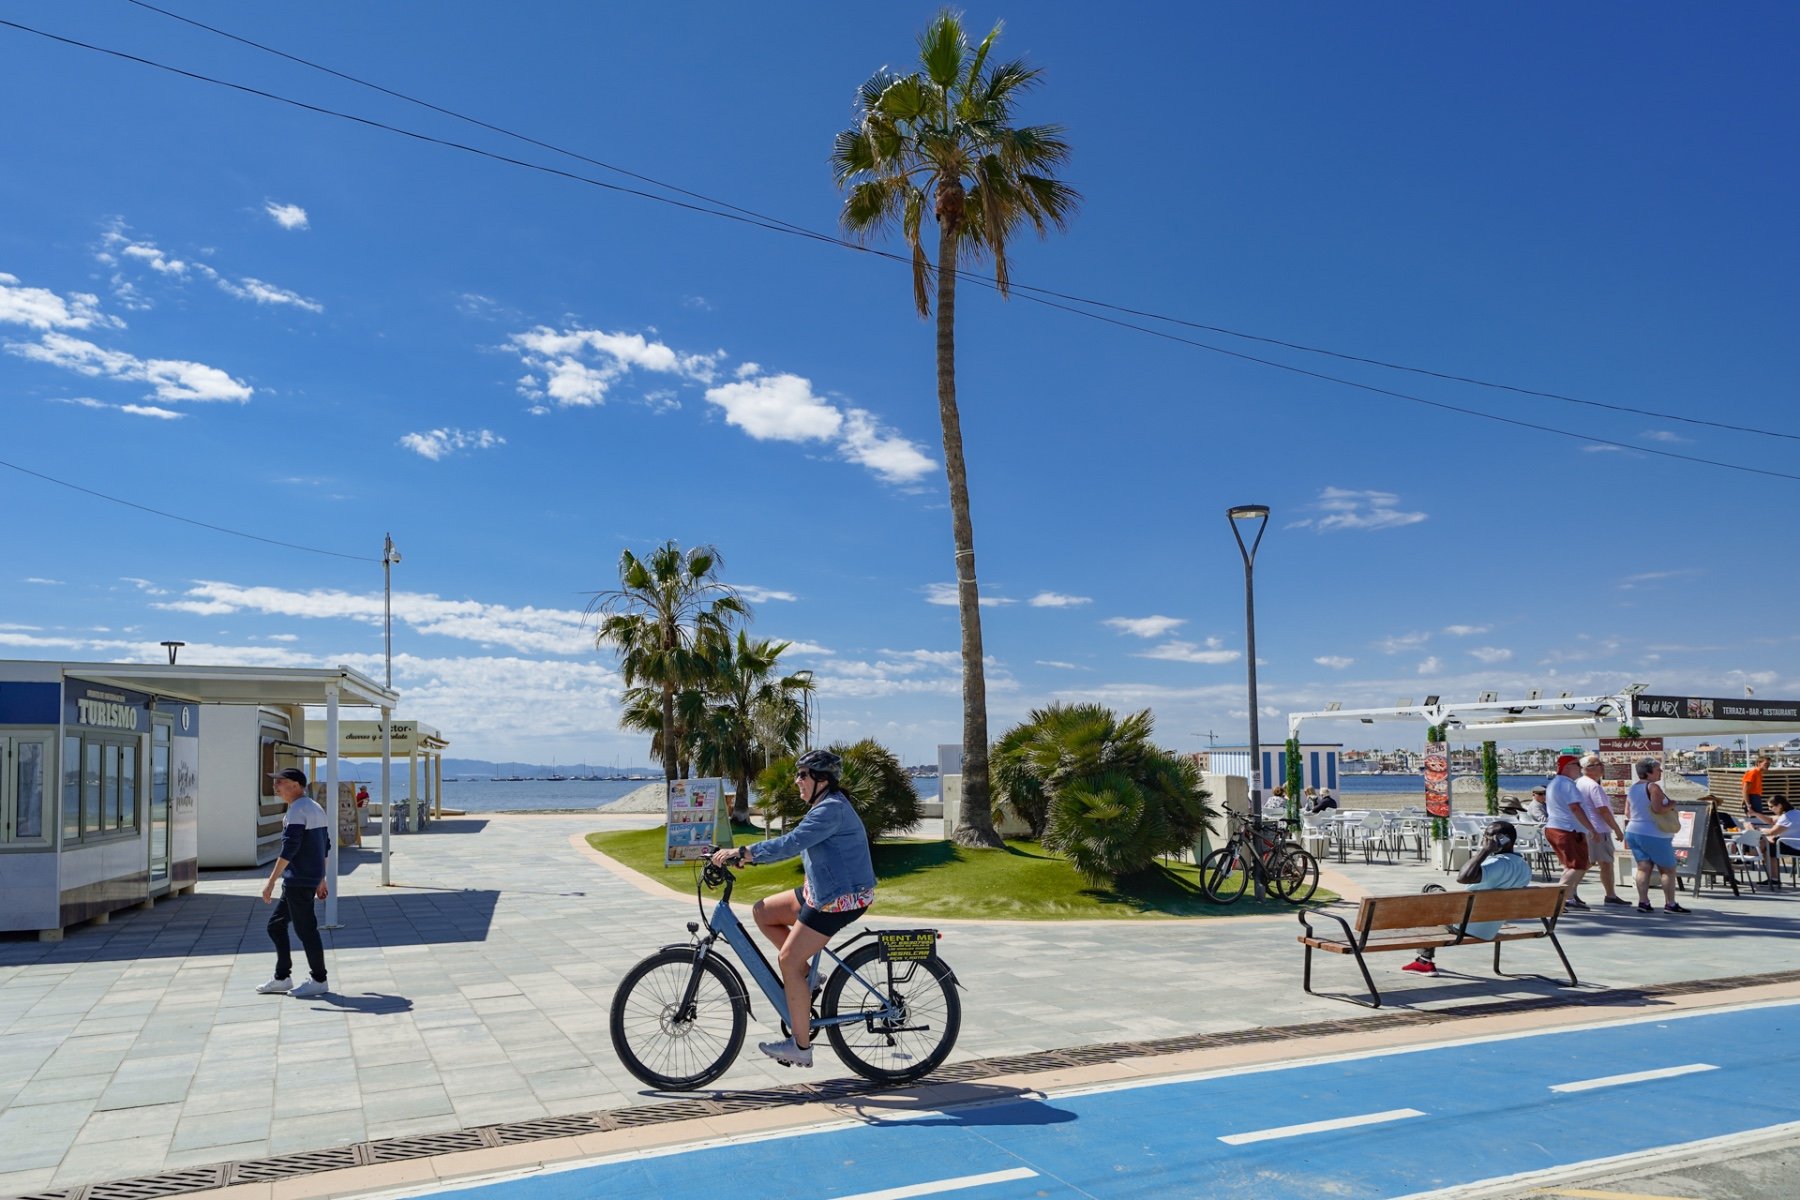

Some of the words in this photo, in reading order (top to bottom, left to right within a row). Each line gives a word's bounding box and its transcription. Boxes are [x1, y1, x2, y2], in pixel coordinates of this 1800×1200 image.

[78, 698, 137, 730] TURISMO
[1722, 706, 1746, 716] TERRAZA
[1748, 707, 1760, 716] BAR
[1762, 708, 1798, 717] RESTAURANTE
